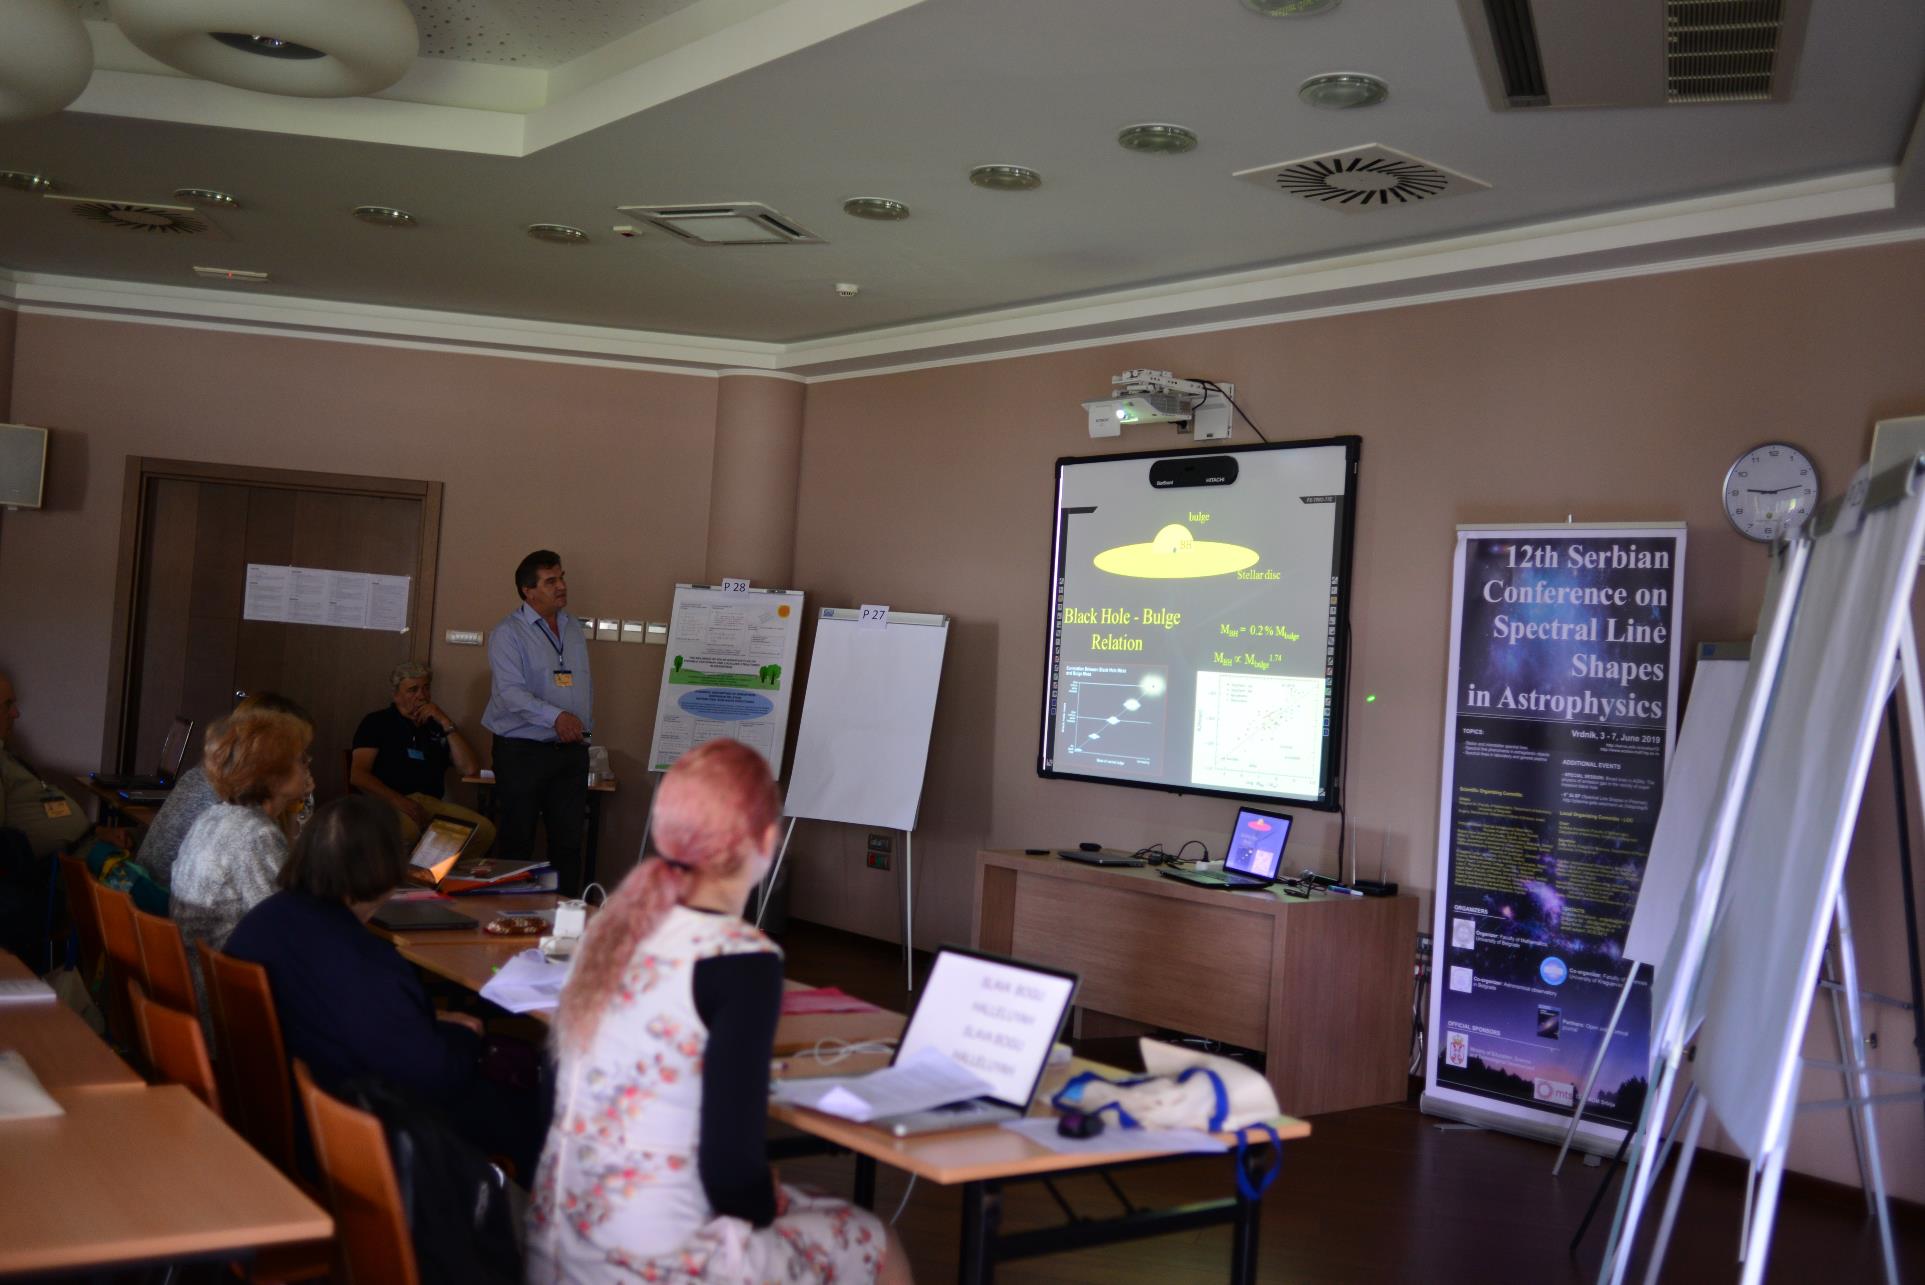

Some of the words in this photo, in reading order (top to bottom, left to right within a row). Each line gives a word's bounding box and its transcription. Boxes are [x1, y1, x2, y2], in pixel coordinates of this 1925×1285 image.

[1189, 511, 1210, 524] bulge
[1505, 544, 1559, 568] 12th
[1567, 544, 1669, 569] Serbian
[1237, 569, 1263, 580] Stellar
[1264, 569, 1280, 580] disc
[733, 583, 746, 592] 28
[1483, 579, 1628, 605] Conference
[1635, 587, 1668, 606] on
[862, 610, 870, 620] P
[871, 610, 885, 621] 27
[1064, 607, 1098, 624] Black
[1101, 607, 1131, 625] Hole
[1142, 608, 1181, 630] Bulge
[1493, 614, 1597, 645] Spectral
[1605, 618, 1667, 644] Line
[1091, 633, 1144, 651] Relation
[1571, 653, 1664, 687] Shapes
[1467, 683, 1491, 707] in
[1497, 686, 1662, 721] Astrophysics
[1620, 733, 1640, 742] June
[1641, 735, 1661, 744] 2019
